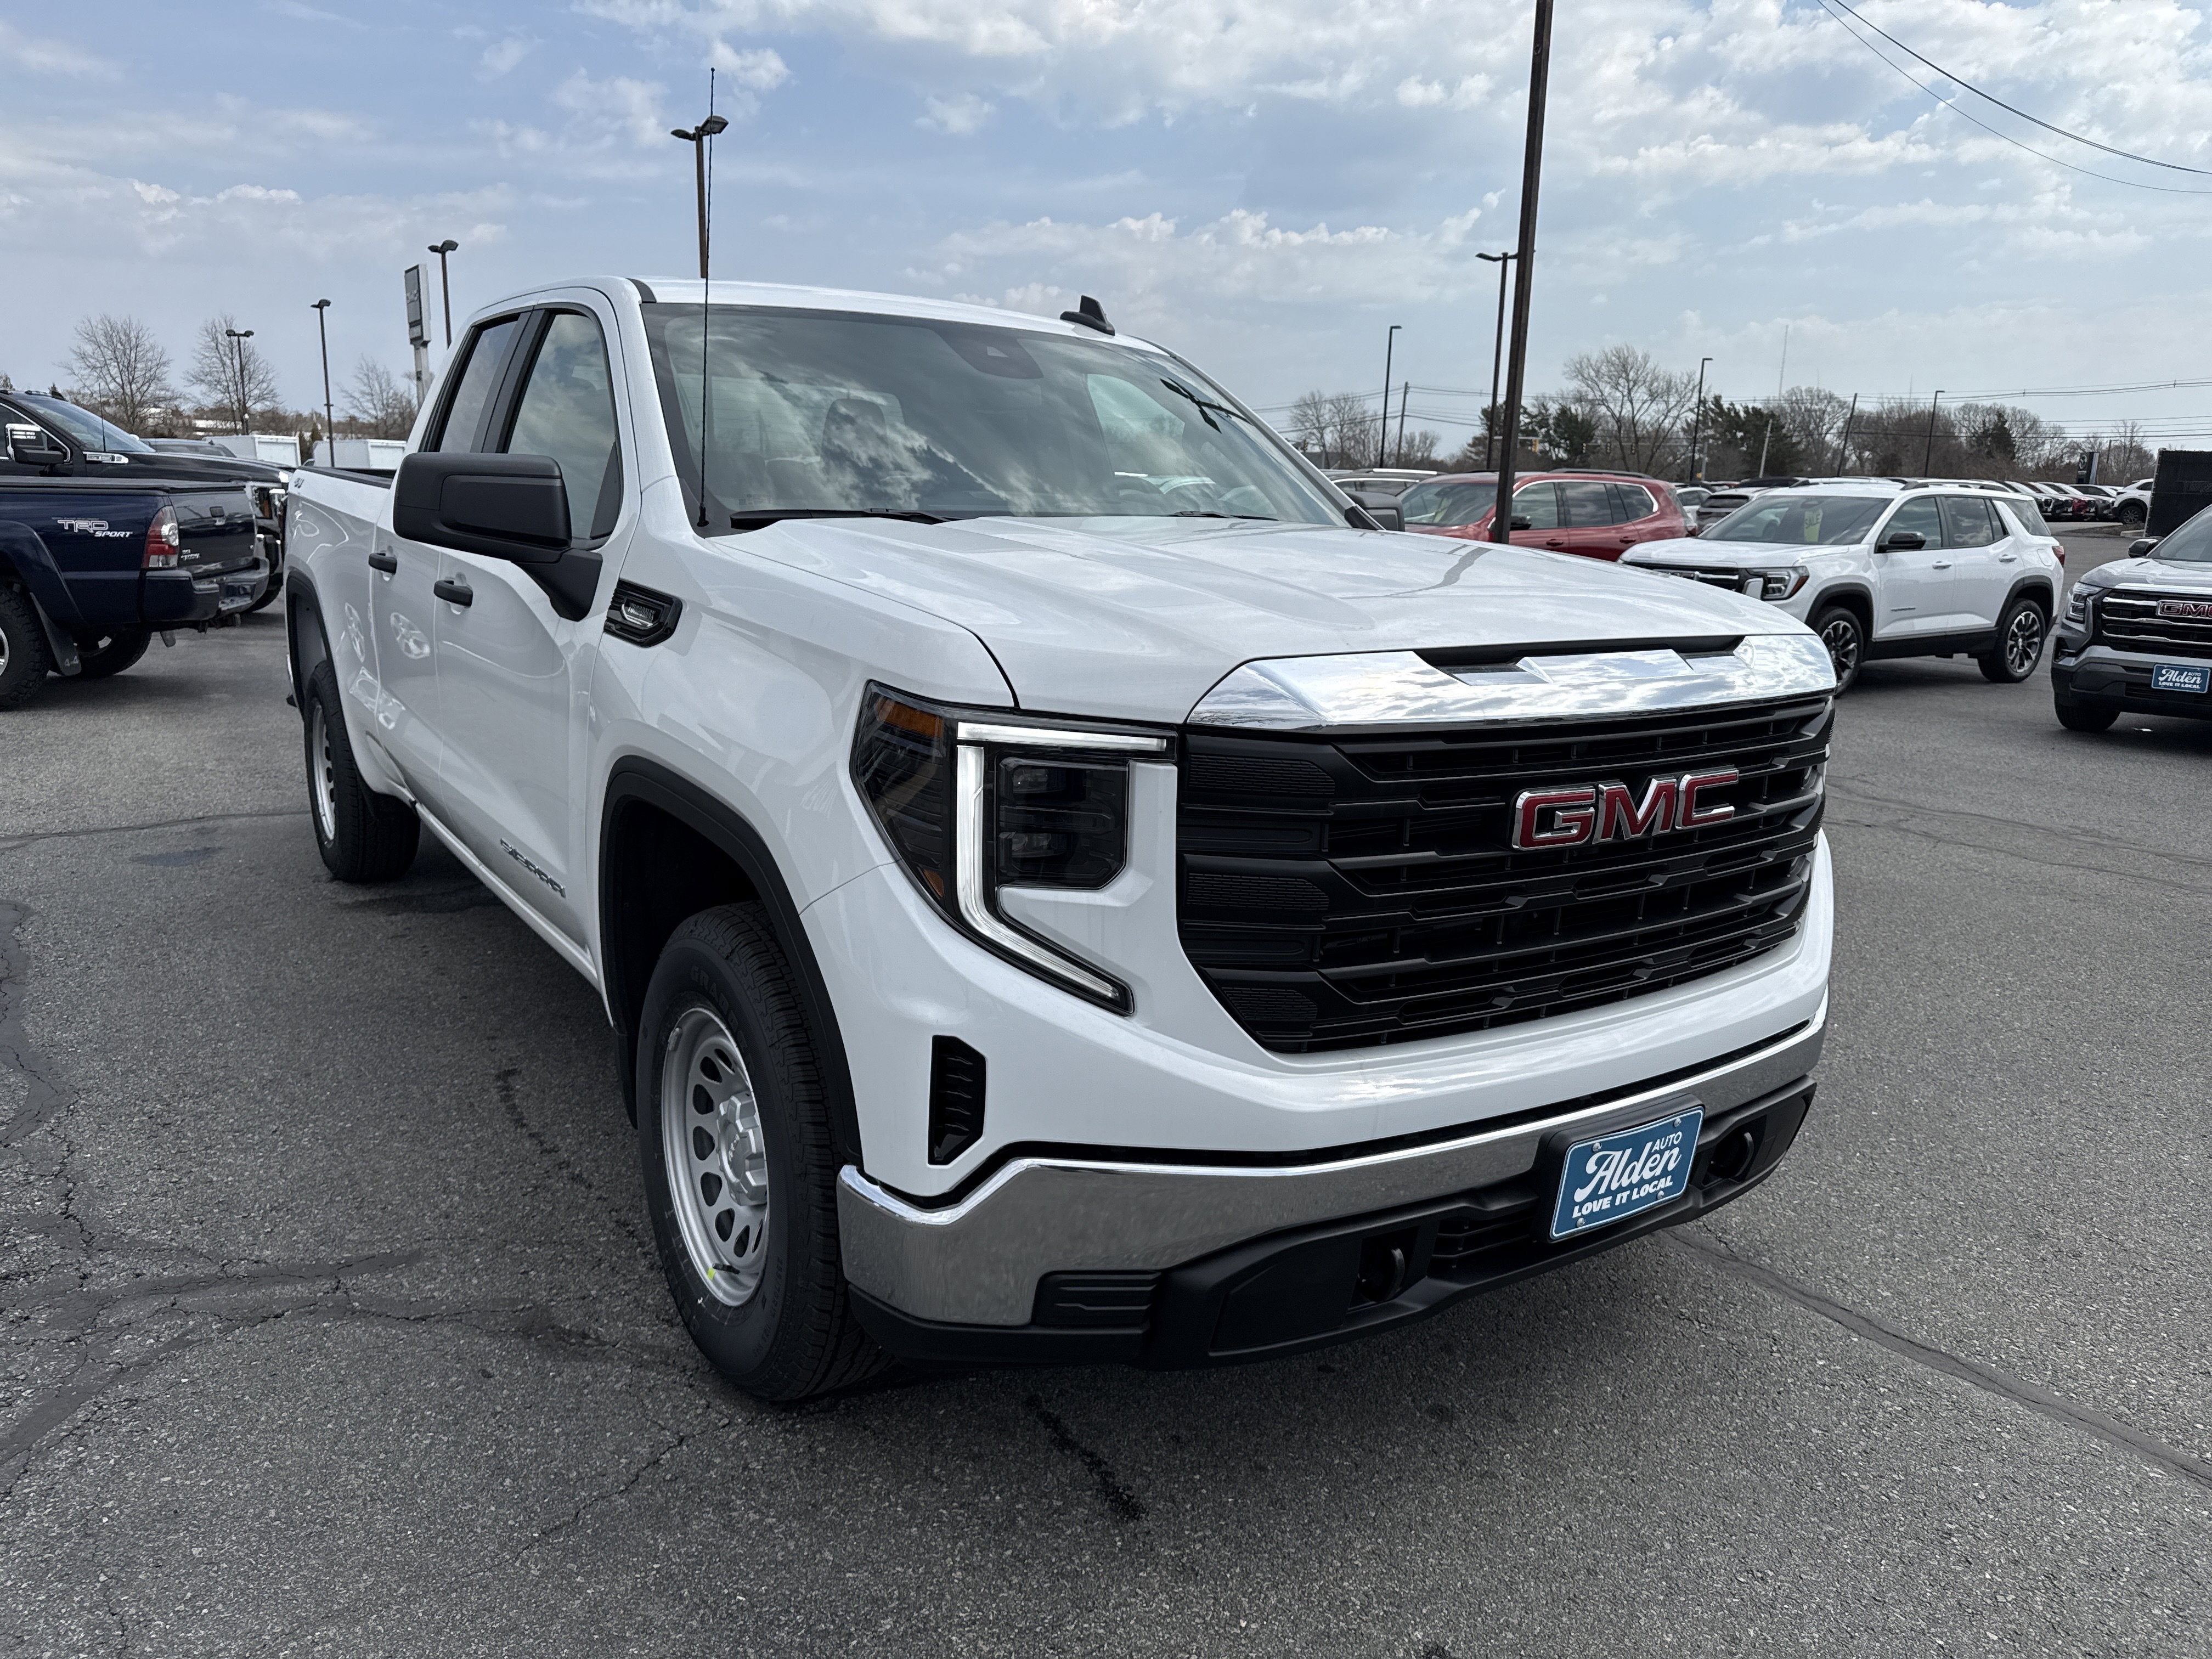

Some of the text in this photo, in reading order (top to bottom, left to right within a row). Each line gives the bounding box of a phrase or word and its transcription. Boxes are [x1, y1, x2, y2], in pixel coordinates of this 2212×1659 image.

[57, 520, 109, 533] TRD
[1805, 513, 1821, 529] SALE
[2158, 668, 2202, 684] Alden
[1511, 769, 1739, 851] GMC
[1651, 1131, 1683, 1153] AUTO
[1573, 1141, 1682, 1203] Alden
[1572, 1175, 1673, 1218] LOVE IT LOCAL
